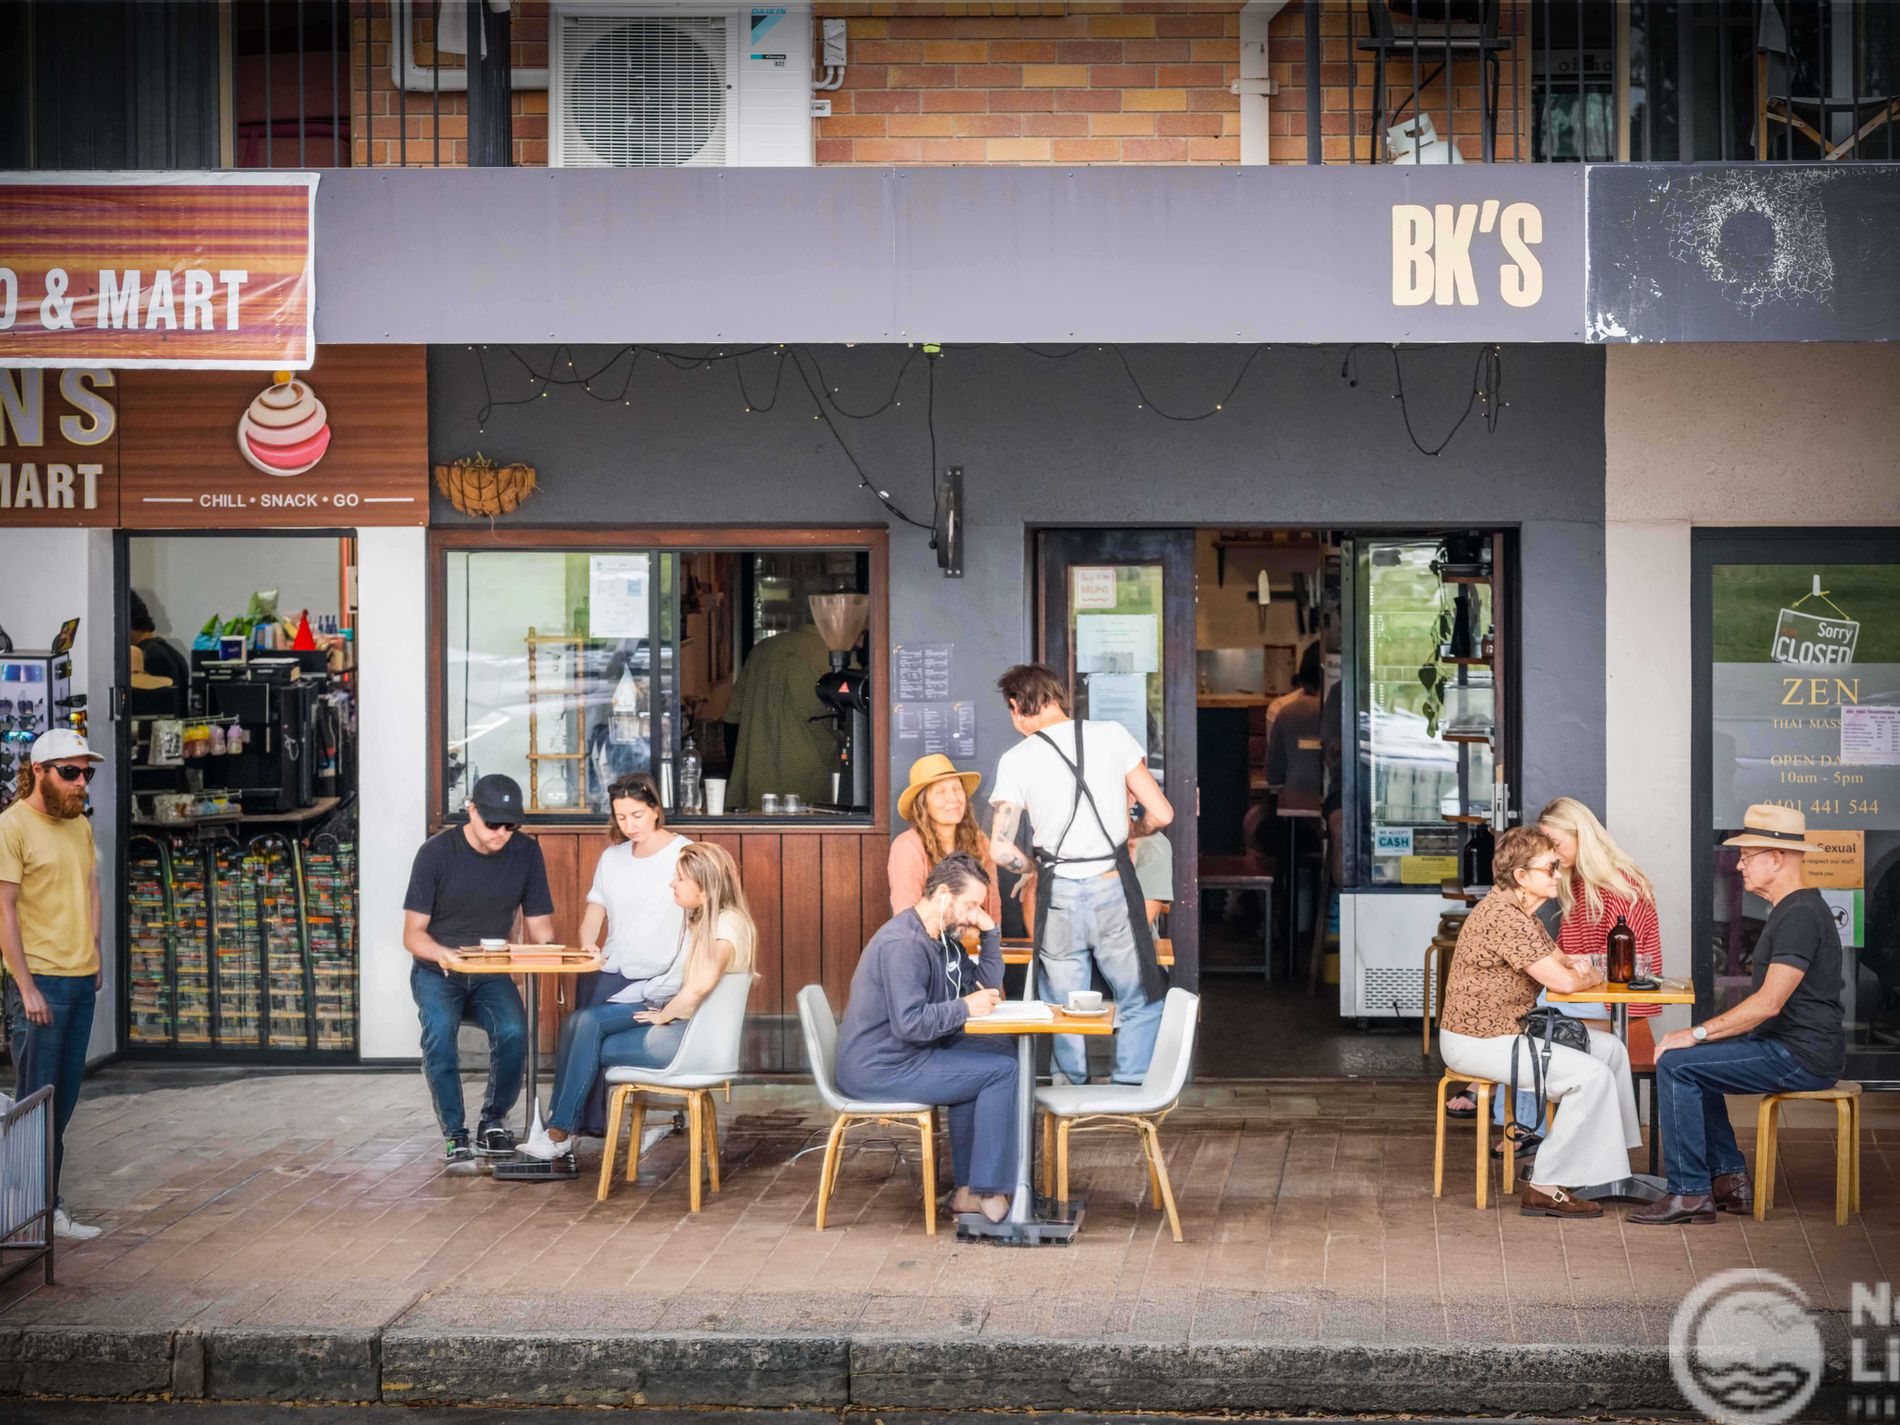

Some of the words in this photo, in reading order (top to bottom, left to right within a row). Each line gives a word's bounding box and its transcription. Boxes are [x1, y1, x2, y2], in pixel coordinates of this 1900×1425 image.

[1392, 200, 1543, 307] BK'S
[40, 268, 75, 329] &
[97, 269, 248, 330] MART
[200, 494, 247, 508] CHILL
[260, 494, 318, 507] SNACK
[333, 493, 359, 507] GO
[1817, 622, 1853, 644] Sorry
[1776, 636, 1851, 664] CLOSED
[1781, 678, 1860, 706] ZEN
[1771, 719, 1802, 729] THAI
[1809, 719, 1842, 729] MASS
[1770, 754, 1815, 767] OPEN
[1780, 771, 1818, 784] 10am
[1833, 771, 1864, 787] 5pm
[1810, 799, 1840, 815] 441
[1848, 799, 1880, 815] 544
[1379, 837, 1409, 847] CASH
